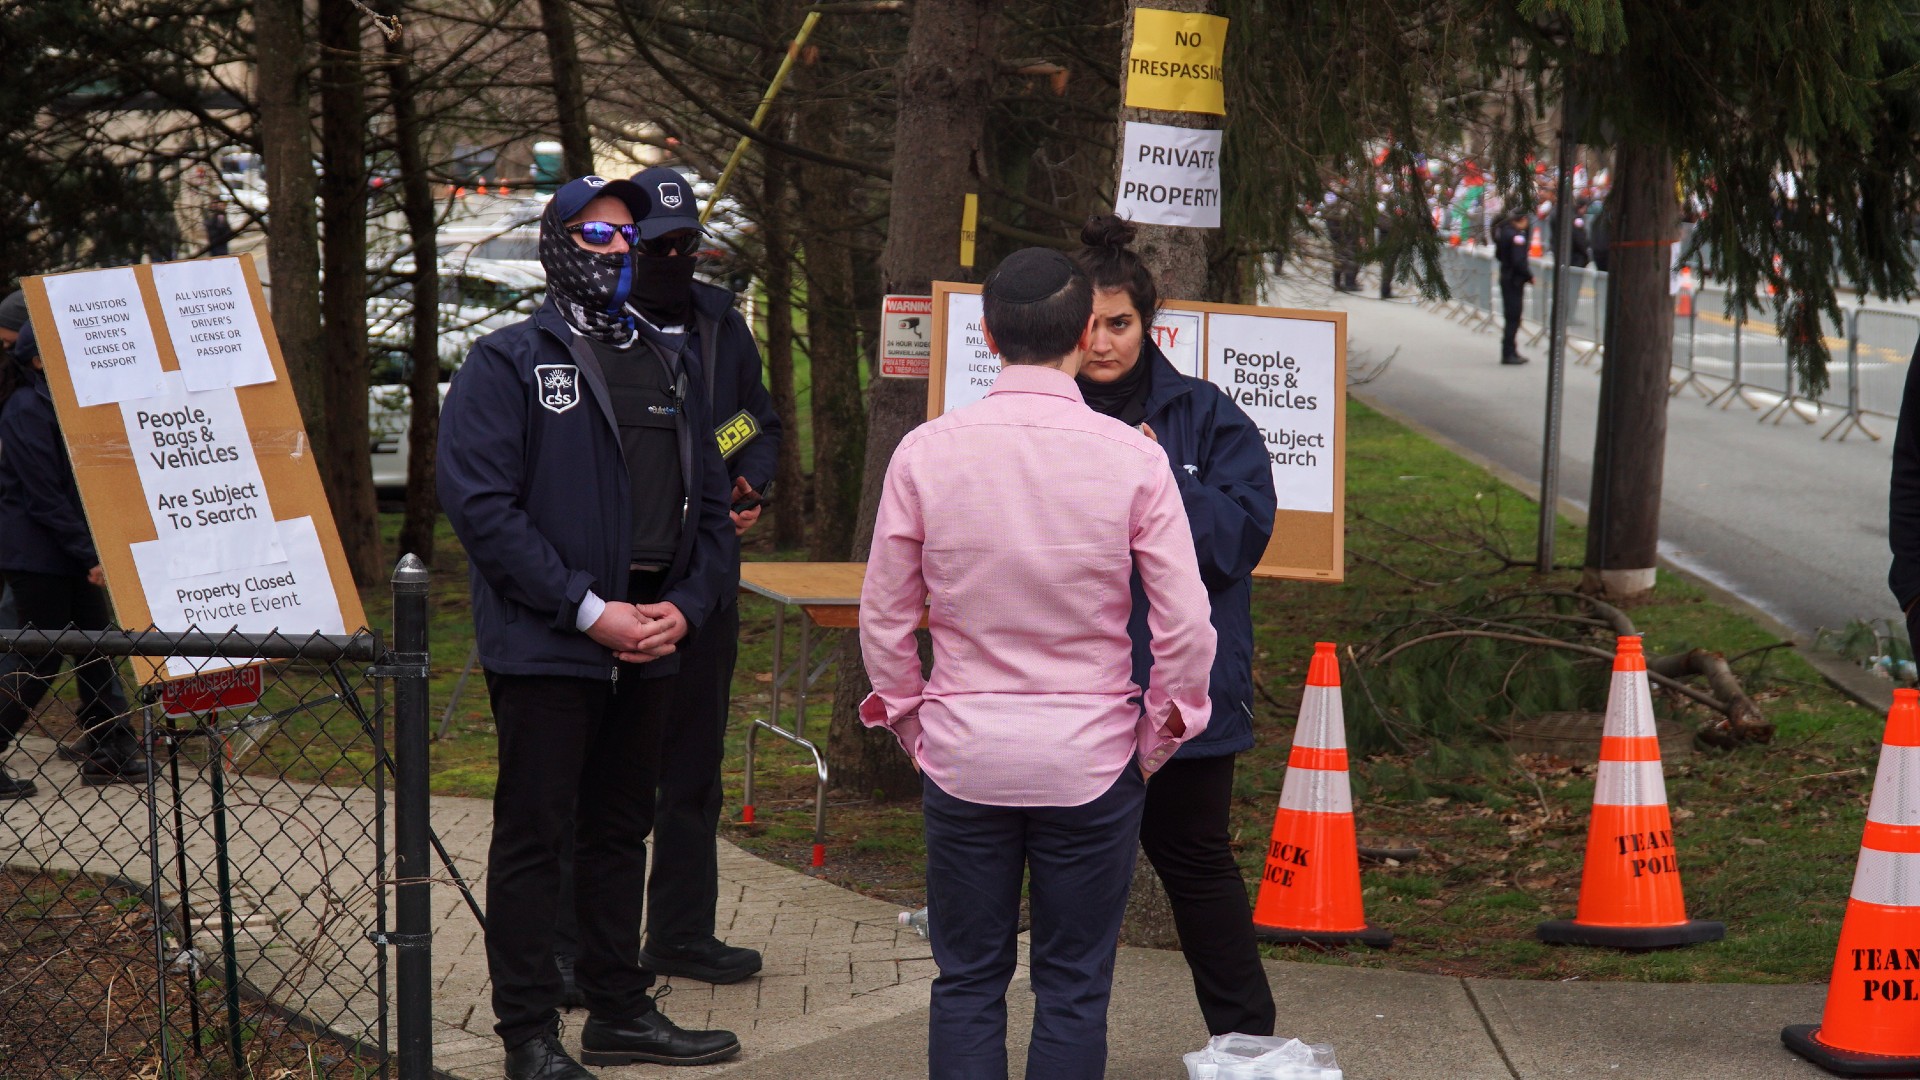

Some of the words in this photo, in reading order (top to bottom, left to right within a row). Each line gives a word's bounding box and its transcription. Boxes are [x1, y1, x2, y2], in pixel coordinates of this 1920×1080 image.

[1175, 31, 1201, 48] NO
[1139, 144, 1215, 169] PRIVATE
[664, 195, 680, 203] CSS
[1123, 181, 1218, 207] PROPERTY
[174, 291, 191, 301] ALL
[192, 287, 233, 299] VISITORS
[69, 303, 84, 313] ALL
[85, 298, 127, 311] VISITORS
[179, 305, 206, 317] MUST
[207, 301, 236, 312] SHOW
[73, 316, 100, 329] MUST
[101, 312, 130, 323] SHOW
[191, 316, 232, 328] DRIVER'S
[966, 323, 983, 331] ALL
[85, 328, 127, 340] DRIVER'S
[190, 331, 226, 343] LICENSE
[227, 329, 242, 339] OR
[966, 336, 988, 345] MU
[1153, 326, 1178, 348] TY
[84, 343, 120, 356] LICENSE
[121, 341, 136, 350] OR
[197, 344, 242, 356] PASSPORT
[91, 356, 136, 369] PASSPORT
[969, 363, 1002, 373] LICENS
[1223, 348, 1301, 373] People,
[970, 377, 994, 387] PASS
[1234, 368, 1280, 390] Bags
[1283, 372, 1298, 389] &
[545, 394, 571, 404] CSS
[1225, 386, 1317, 411] Vehicles
[137, 405, 212, 430] People,
[152, 430, 198, 449] Bags
[200, 426, 215, 443] &
[716, 418, 752, 454] SCA
[150, 444, 239, 470] Vehicles
[1269, 450, 1317, 467] earch
[158, 494, 188, 510] Are
[192, 482, 259, 506] Subject
[167, 513, 192, 530] To
[196, 503, 257, 526] Search
[176, 583, 240, 603] Property
[245, 571, 296, 592] Closed
[184, 601, 246, 623] Private
[251, 591, 301, 613] Event
[1862, 979, 1920, 1002] POL
